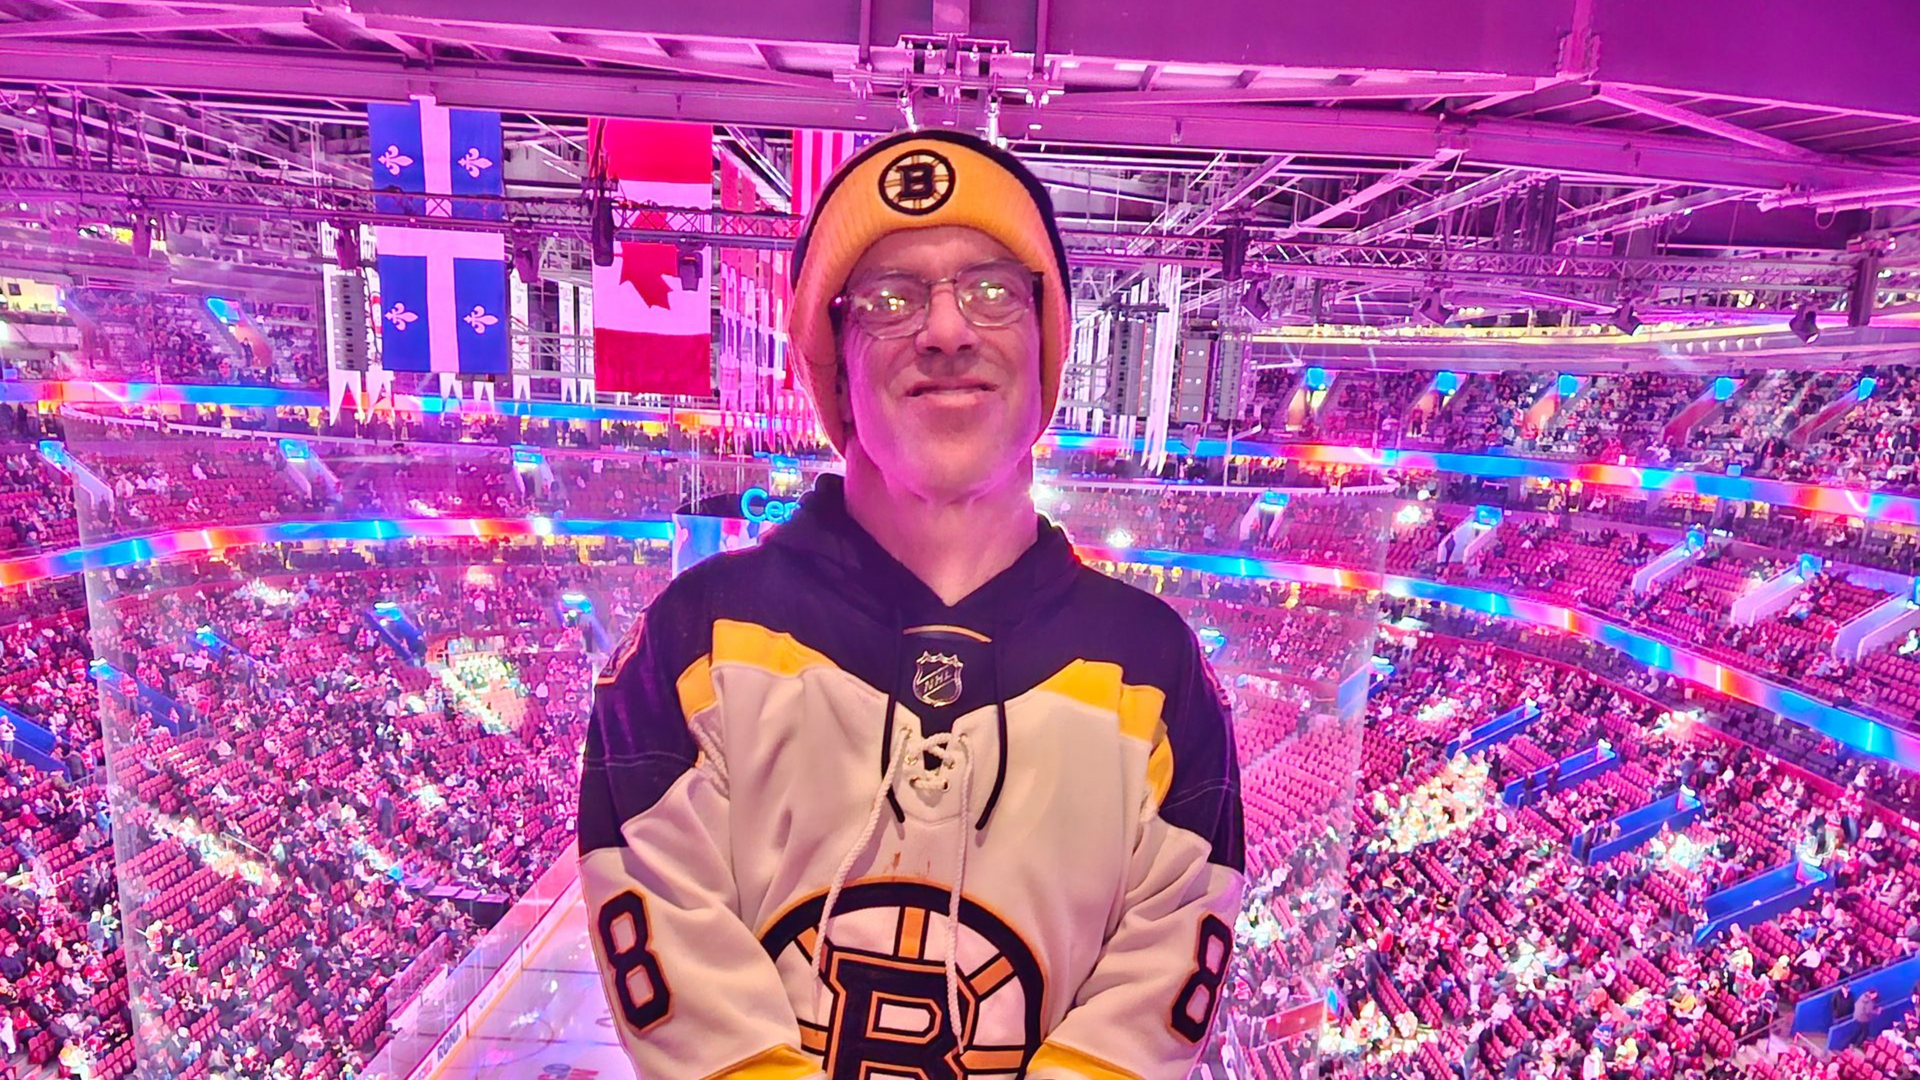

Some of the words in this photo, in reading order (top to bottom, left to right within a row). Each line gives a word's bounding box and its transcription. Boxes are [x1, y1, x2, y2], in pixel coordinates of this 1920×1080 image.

[895, 162, 936, 202] B
[923, 670, 952, 693] NHL
[598, 889, 672, 1034] 8
[1170, 912, 1234, 1044] 8
[437, 1023, 462, 1062] RONA
